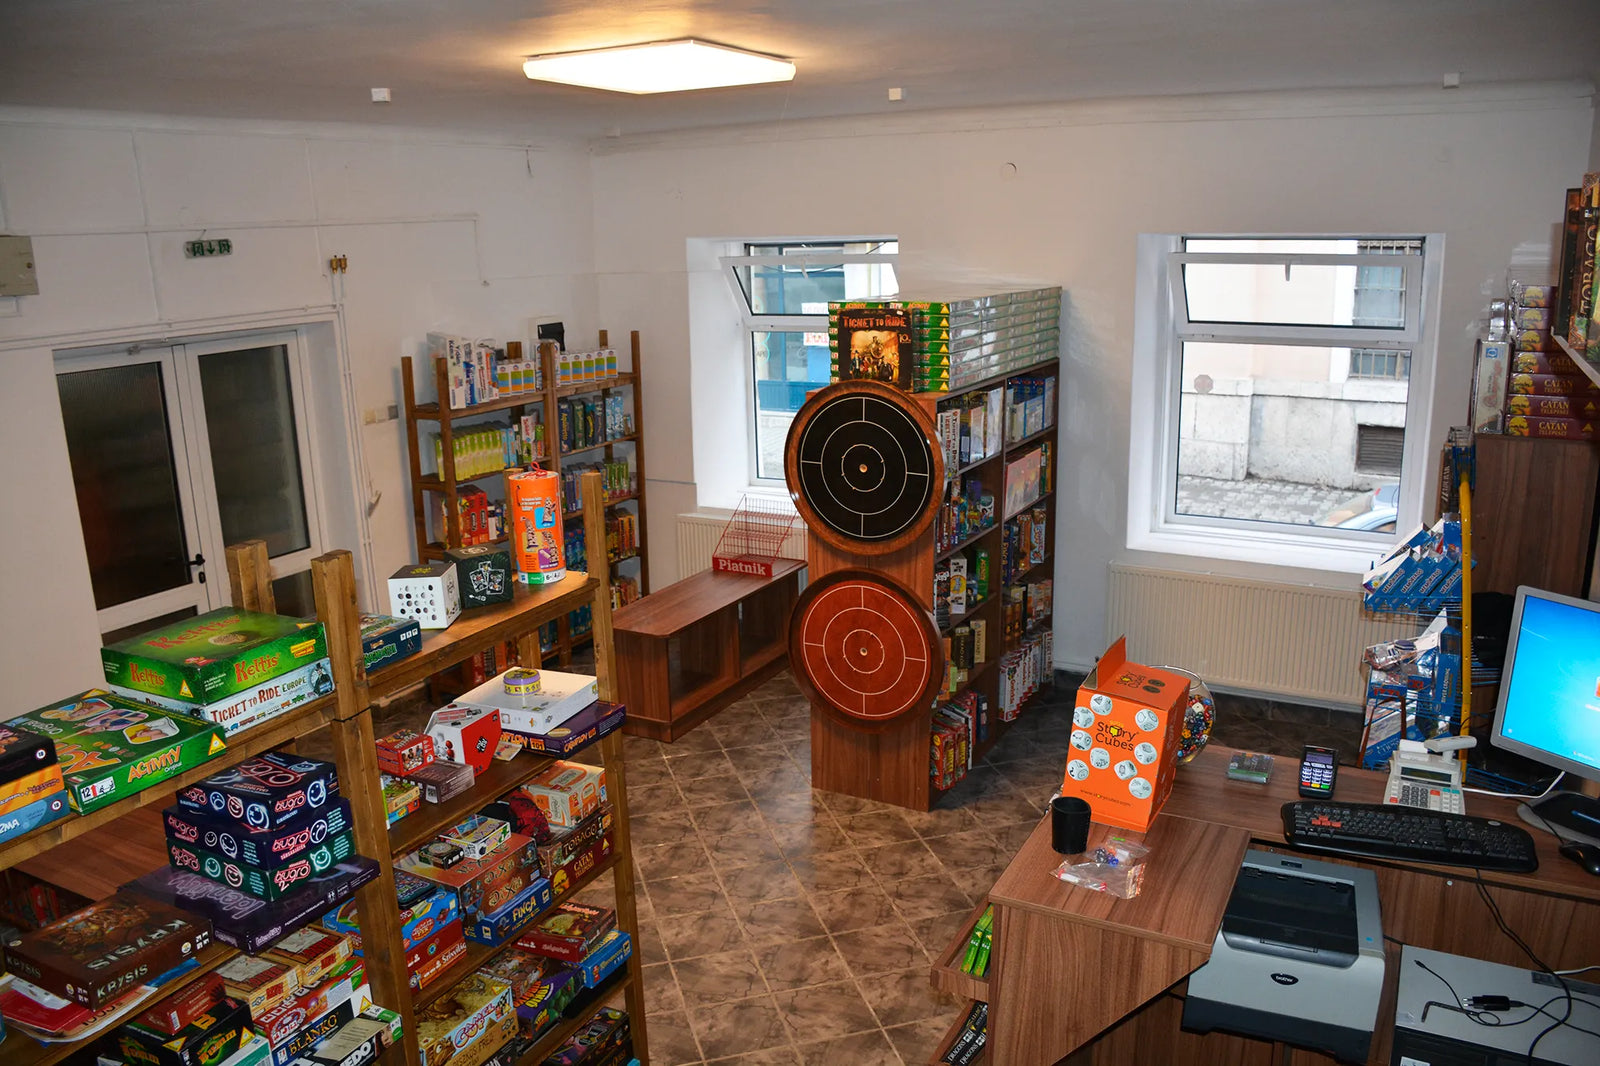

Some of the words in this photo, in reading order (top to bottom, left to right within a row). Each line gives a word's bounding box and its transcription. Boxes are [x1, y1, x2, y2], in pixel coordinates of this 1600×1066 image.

[843, 316, 874, 328] TICKET
[876, 318, 884, 326] TO
[884, 315, 907, 328] RIDE
[1540, 400, 1569, 409] CATAN
[1538, 422, 1567, 431] CATAN
[718, 559, 766, 576] Piatnik
[129, 662, 165, 686] Keltis
[233, 654, 279, 684] Keltis
[210, 699, 247, 723] TICKET
[248, 697, 258, 708] TO
[258, 686, 282, 704] RIDE
[282, 675, 308, 693] EUROPE
[1095, 732, 1134, 751] Cubes
[1097, 721, 1137, 742] Story
[127, 745, 181, 783] ACTIVITY
[164, 762, 182, 774] Original
[562, 823, 597, 857] TOBAGO
[573, 850, 594, 871] CATAN
[512, 895, 537, 921] FINCA
[97, 963, 148, 999] KRYSIS
[290, 1014, 337, 1055] BLANKO
